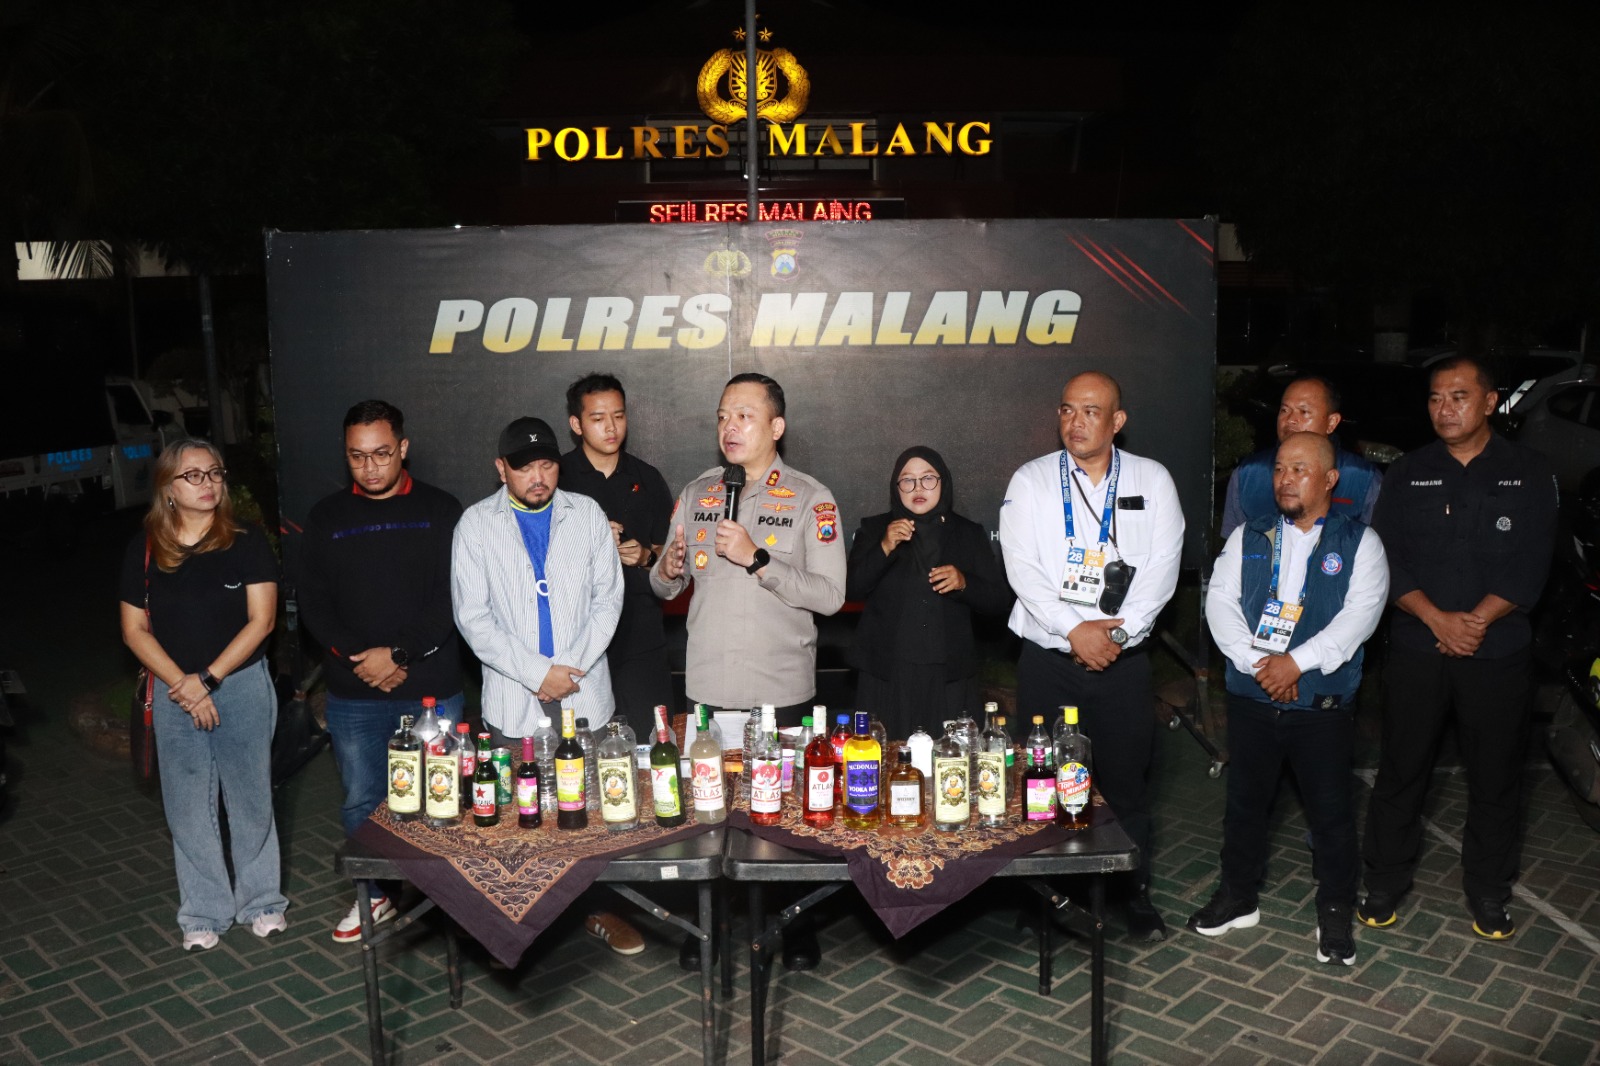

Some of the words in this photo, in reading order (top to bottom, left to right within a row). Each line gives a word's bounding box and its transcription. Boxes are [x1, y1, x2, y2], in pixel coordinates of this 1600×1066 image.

[525, 124, 729, 161] POLRES
[767, 121, 993, 157] MALANG
[428, 292, 732, 354] POLRES
[750, 288, 1082, 348] MALANG
[693, 512, 720, 523] TAAT
[758, 516, 793, 528] POLRI
[1068, 551, 1083, 563] 28
[1264, 603, 1281, 615] 28
[812, 782, 834, 791] ATLAS
[694, 788, 720, 798] ATLAS
[753, 790, 780, 799] ATLAS
